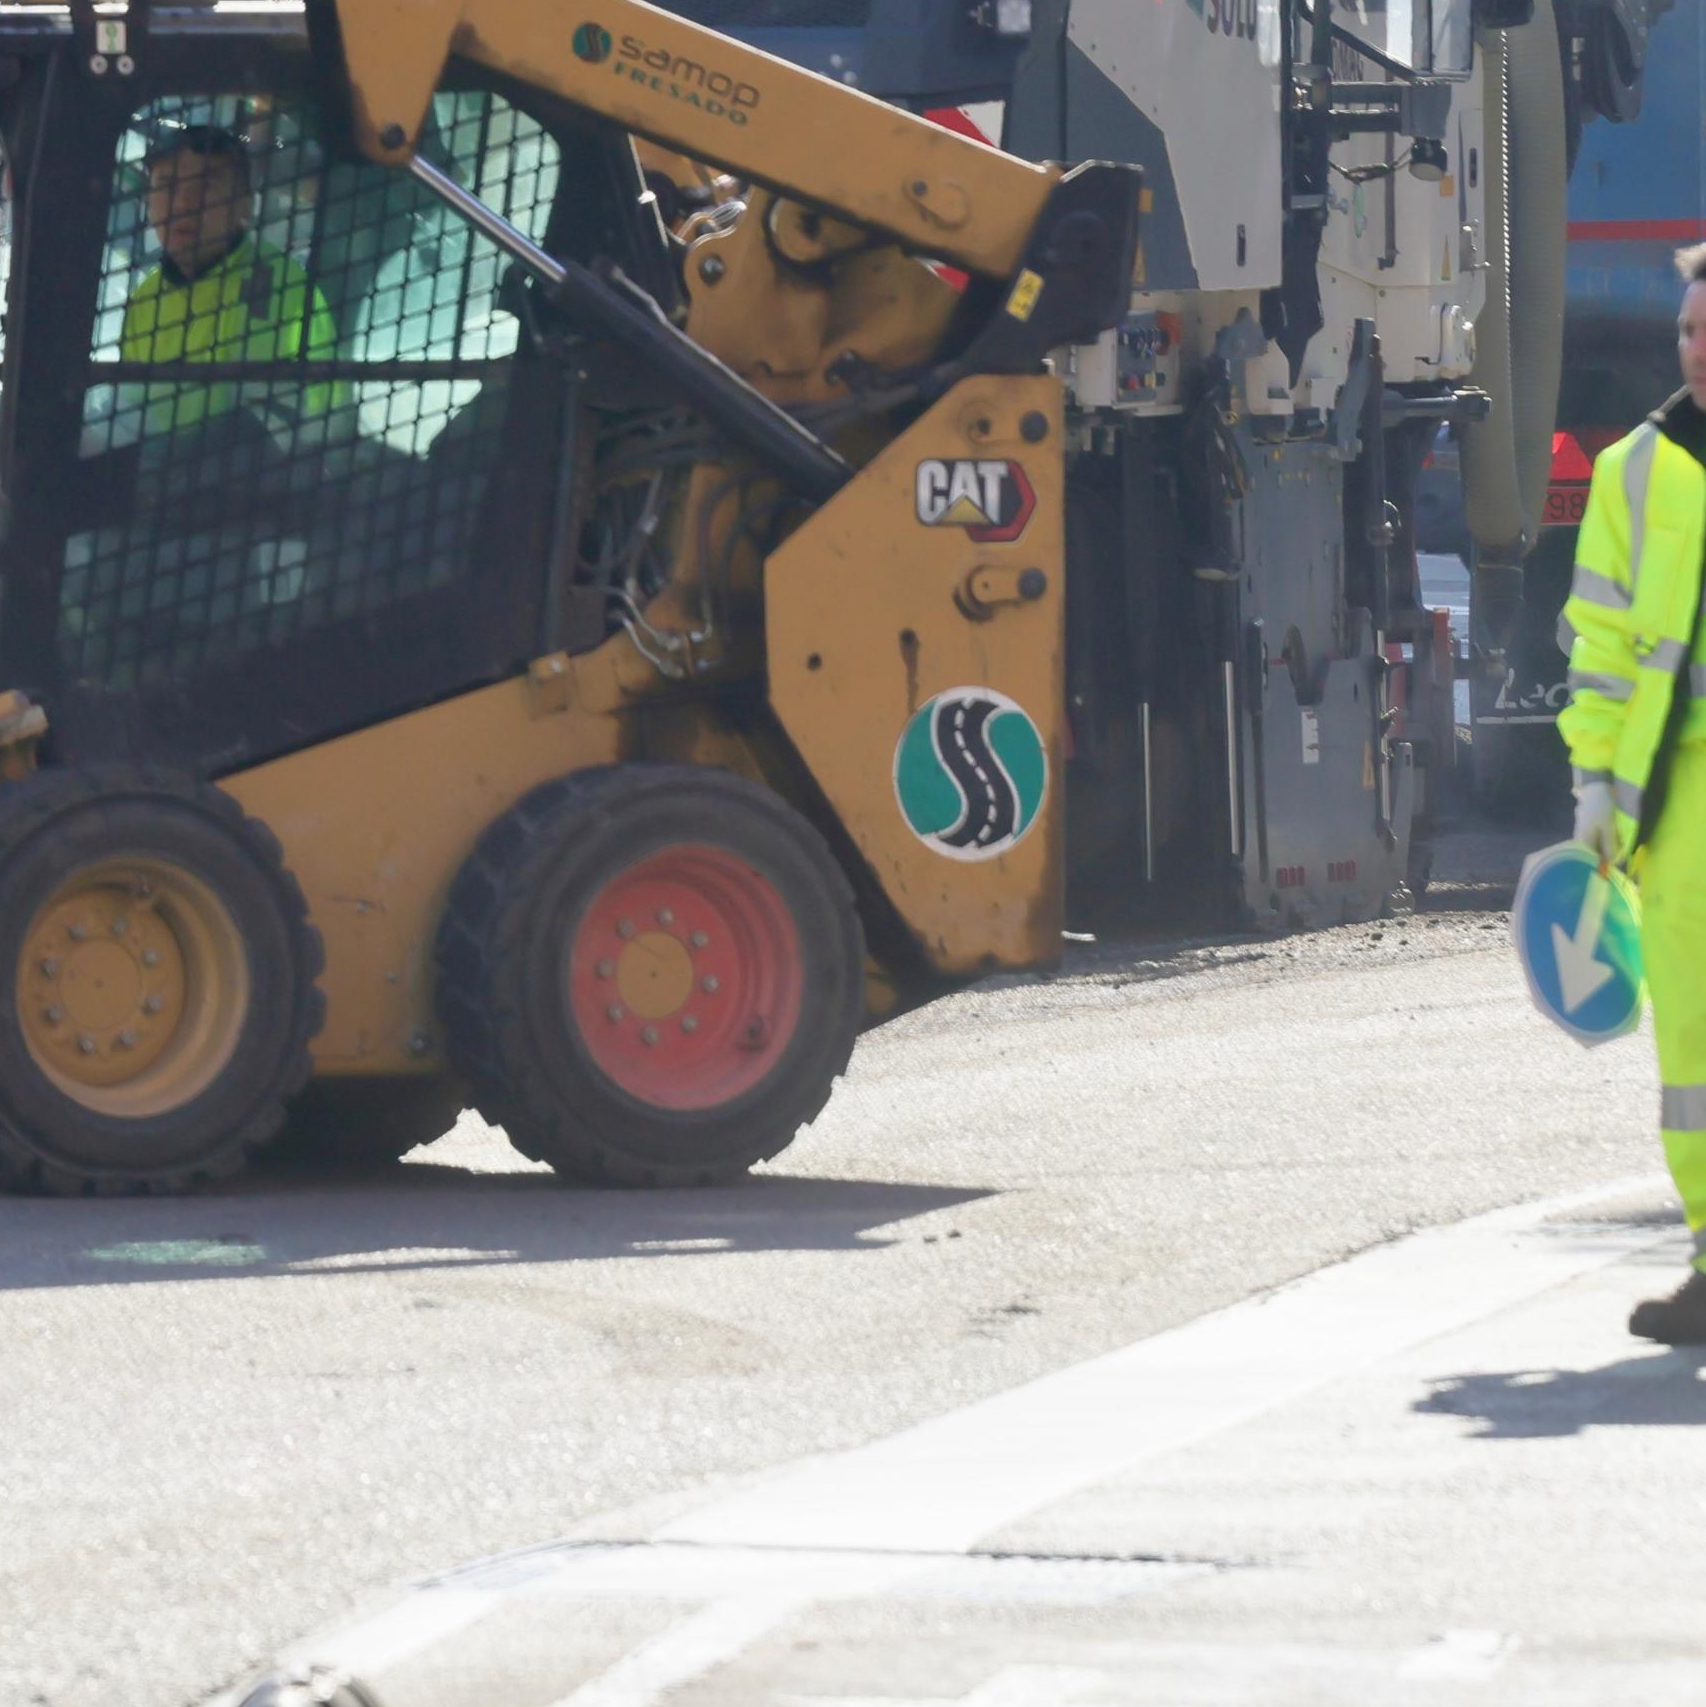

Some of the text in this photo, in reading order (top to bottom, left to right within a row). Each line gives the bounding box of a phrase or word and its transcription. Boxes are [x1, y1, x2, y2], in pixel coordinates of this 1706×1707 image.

[613, 59, 749, 127] FRESADO
[618, 33, 761, 109] samop
[916, 459, 1009, 525] CAT
